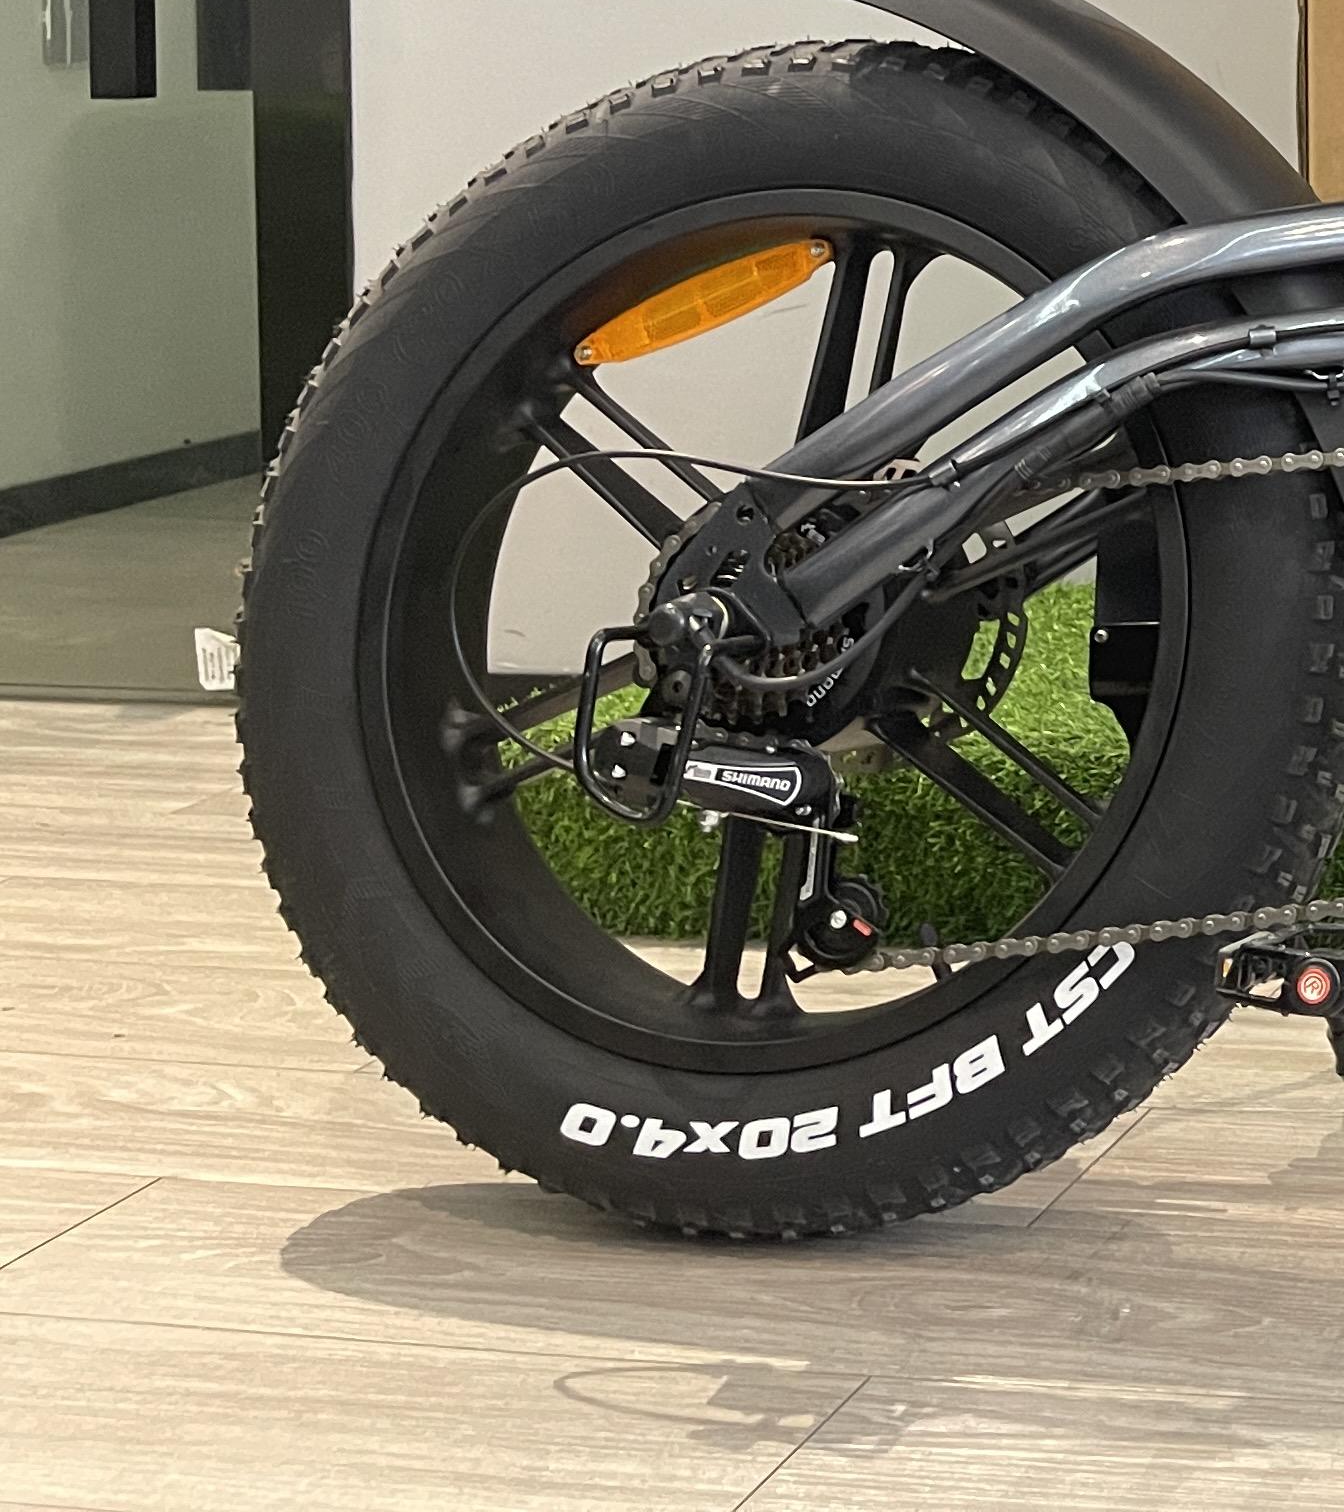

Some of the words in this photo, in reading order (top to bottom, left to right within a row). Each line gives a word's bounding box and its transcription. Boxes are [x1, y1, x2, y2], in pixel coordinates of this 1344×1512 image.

[721, 769, 792, 793] SHIMANO
[1021, 942, 1136, 1056] CST
[858, 1034, 1007, 1139] BFT
[560, 1101, 840, 1161] 20x4.0
